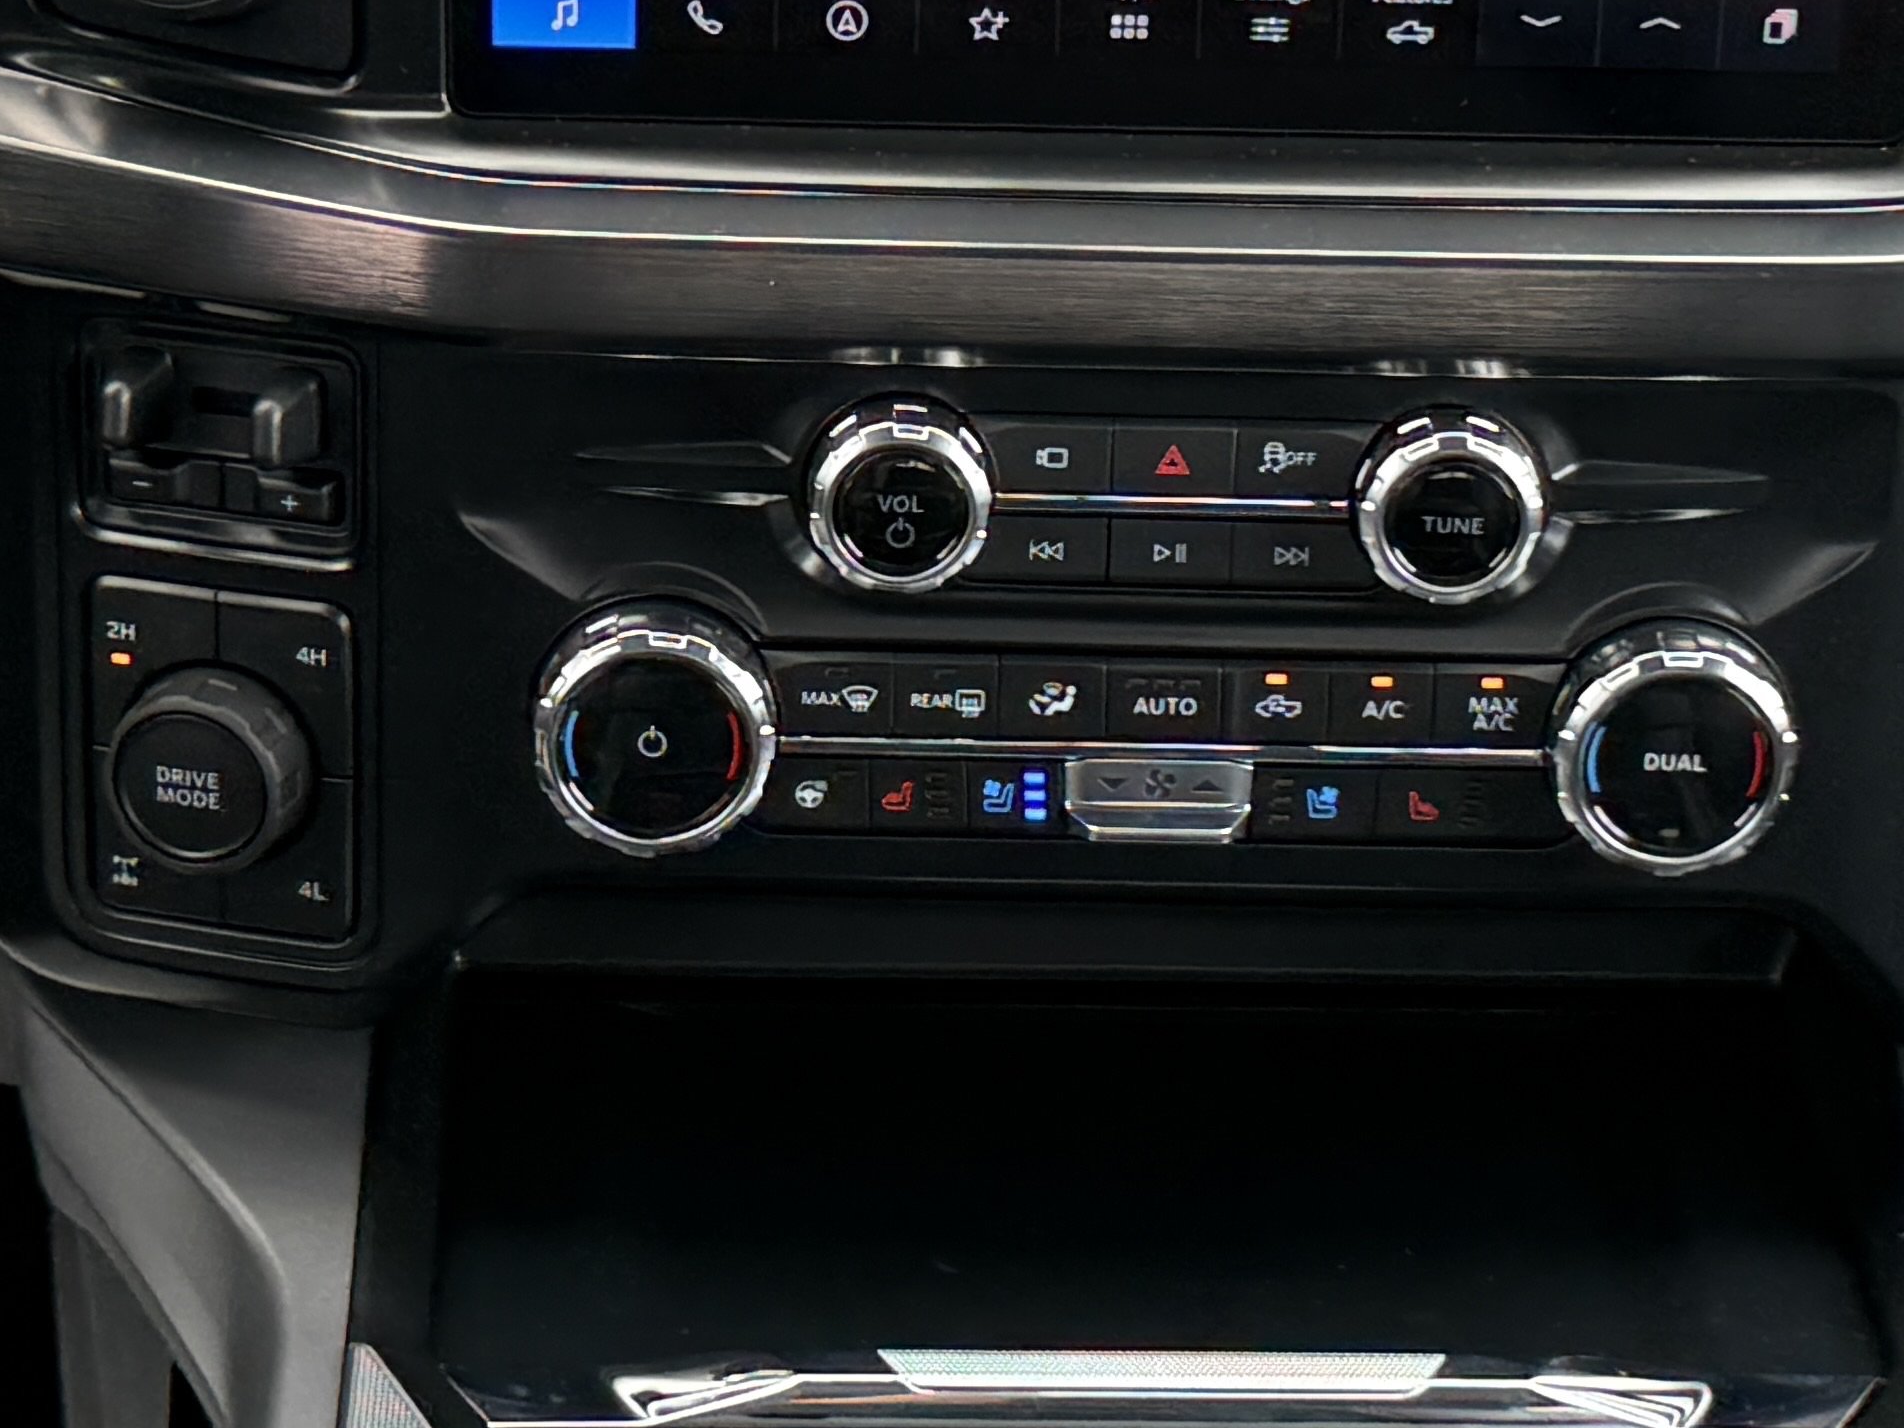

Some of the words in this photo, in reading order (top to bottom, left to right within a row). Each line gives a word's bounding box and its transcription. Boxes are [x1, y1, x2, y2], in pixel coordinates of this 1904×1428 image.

[1286, 451, 1317, 466] OFF
[877, 493, 924, 516] VOL
[1421, 515, 1486, 537] TUNE
[106, 621, 136, 641] 2H
[296, 646, 327, 667] 4H
[801, 691, 840, 707] MAX
[910, 692, 953, 709] REAR
[1133, 696, 1198, 718] AUTO
[1468, 697, 1518, 715] MAX
[1362, 700, 1406, 720] A/C
[1473, 713, 1514, 732] A/C
[1643, 752, 1706, 773] DUAL
[156, 765, 219, 790] DRIVE
[157, 786, 220, 811] MODE
[298, 881, 328, 903] 4L
